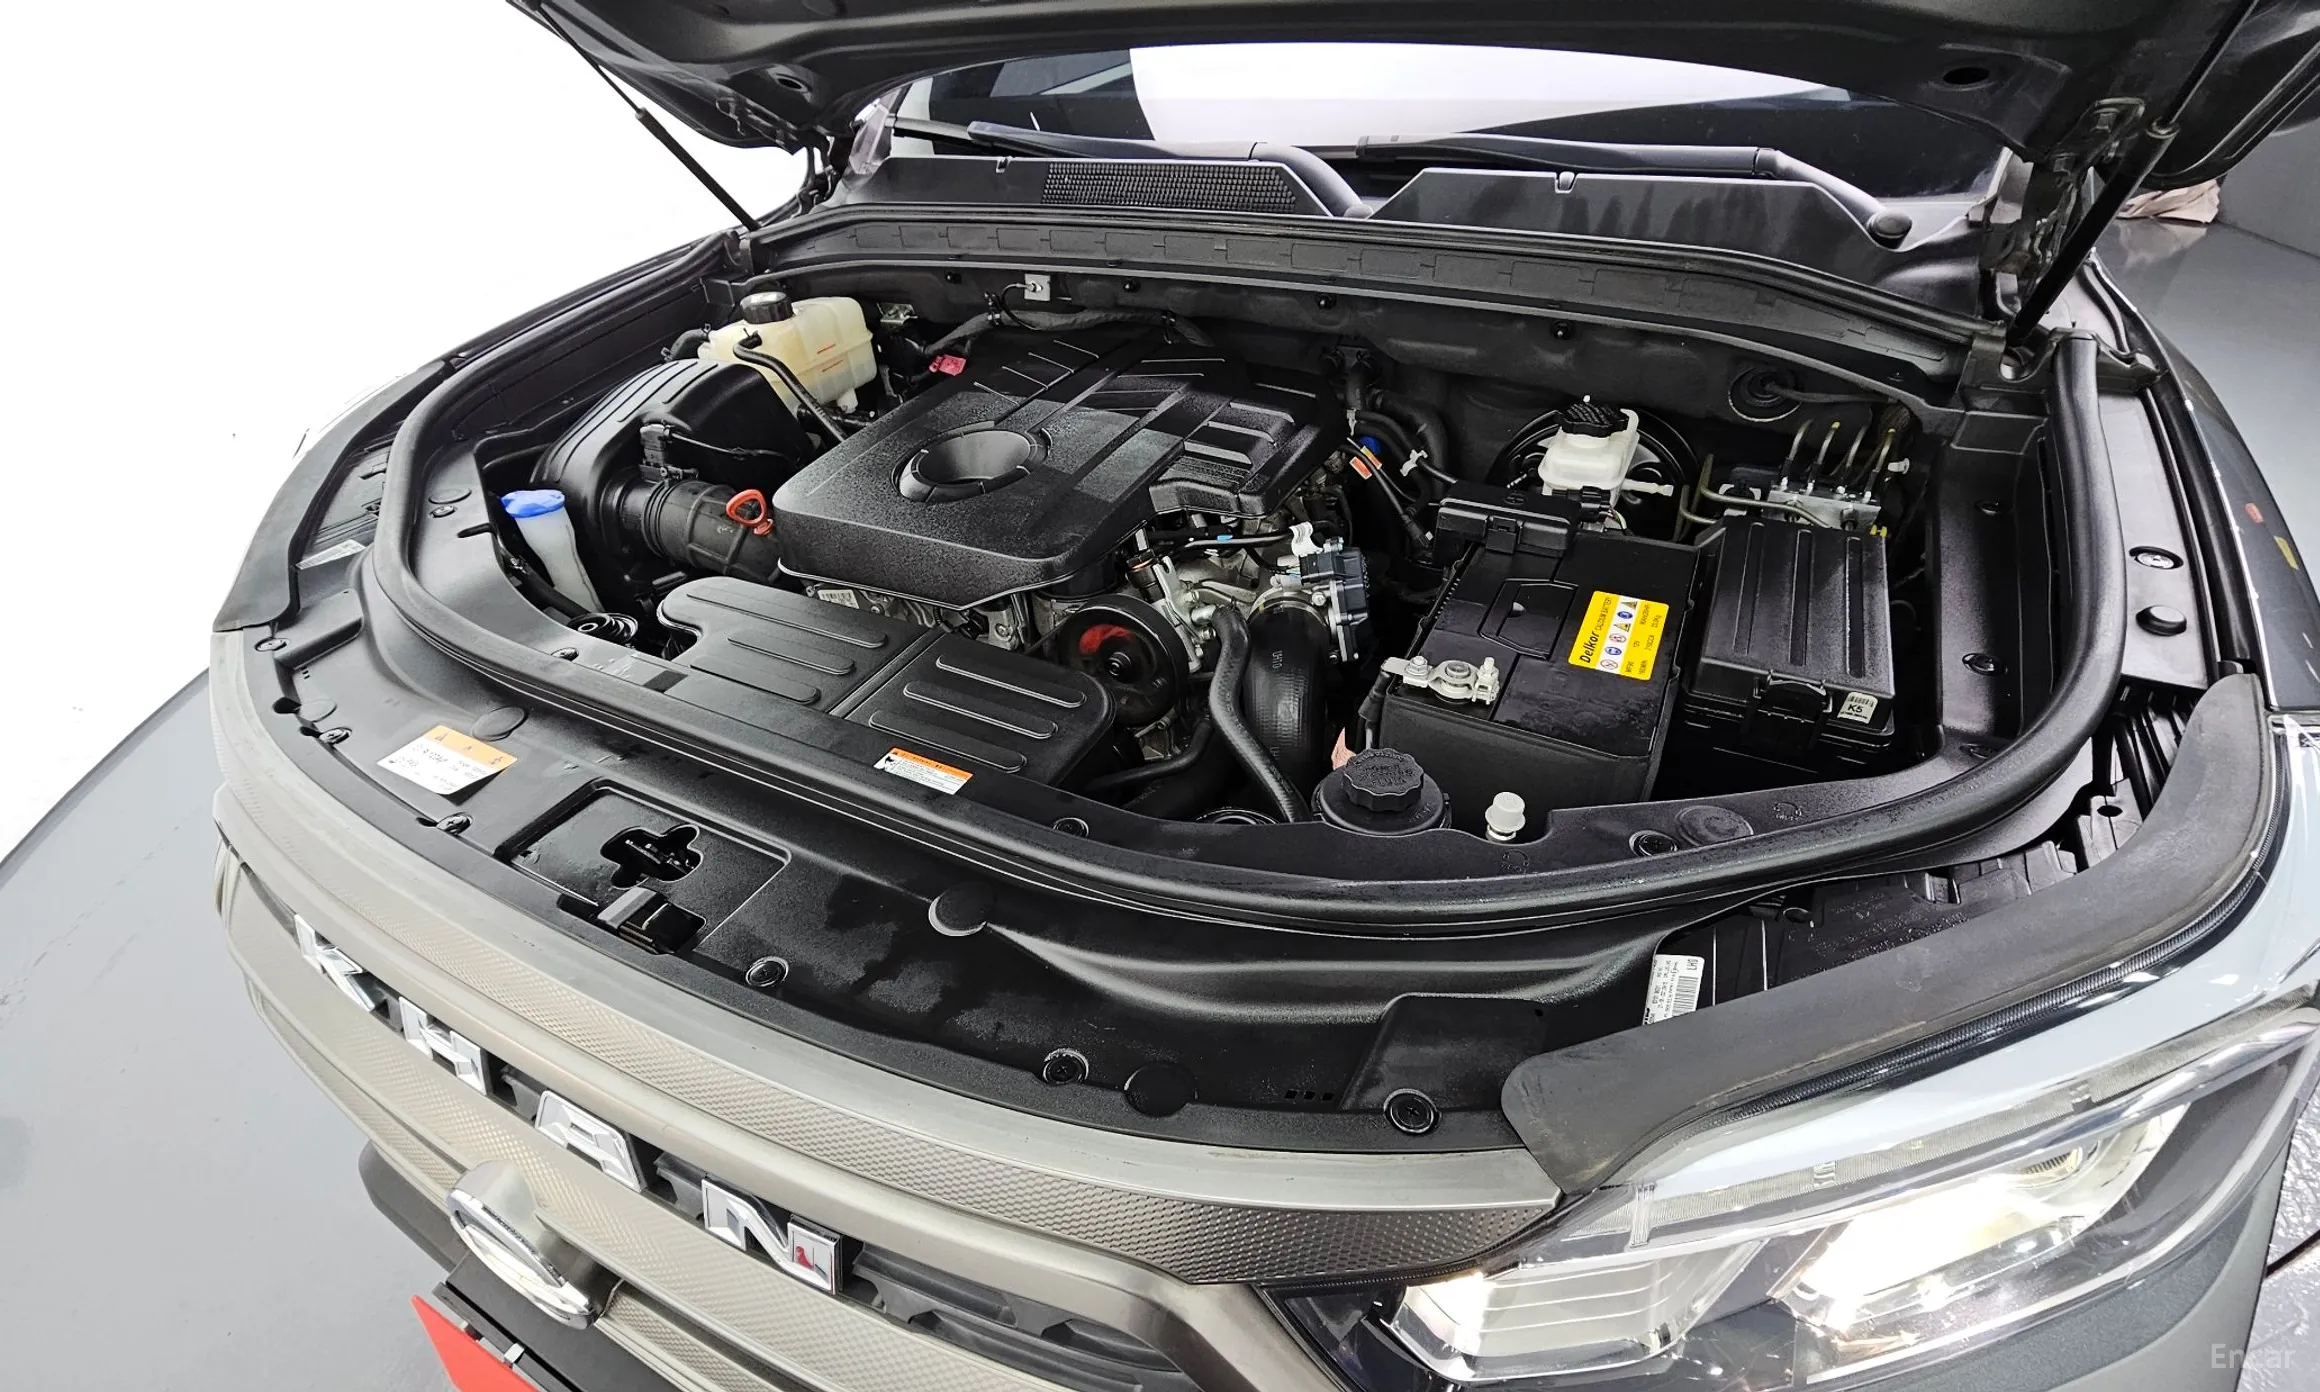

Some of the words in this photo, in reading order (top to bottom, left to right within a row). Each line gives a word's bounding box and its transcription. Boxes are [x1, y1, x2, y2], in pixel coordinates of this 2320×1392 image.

[1580, 631, 1600, 663] Delkor
[1847, 704, 1864, 713] K5
[294, 913, 838, 1294] KHAN
